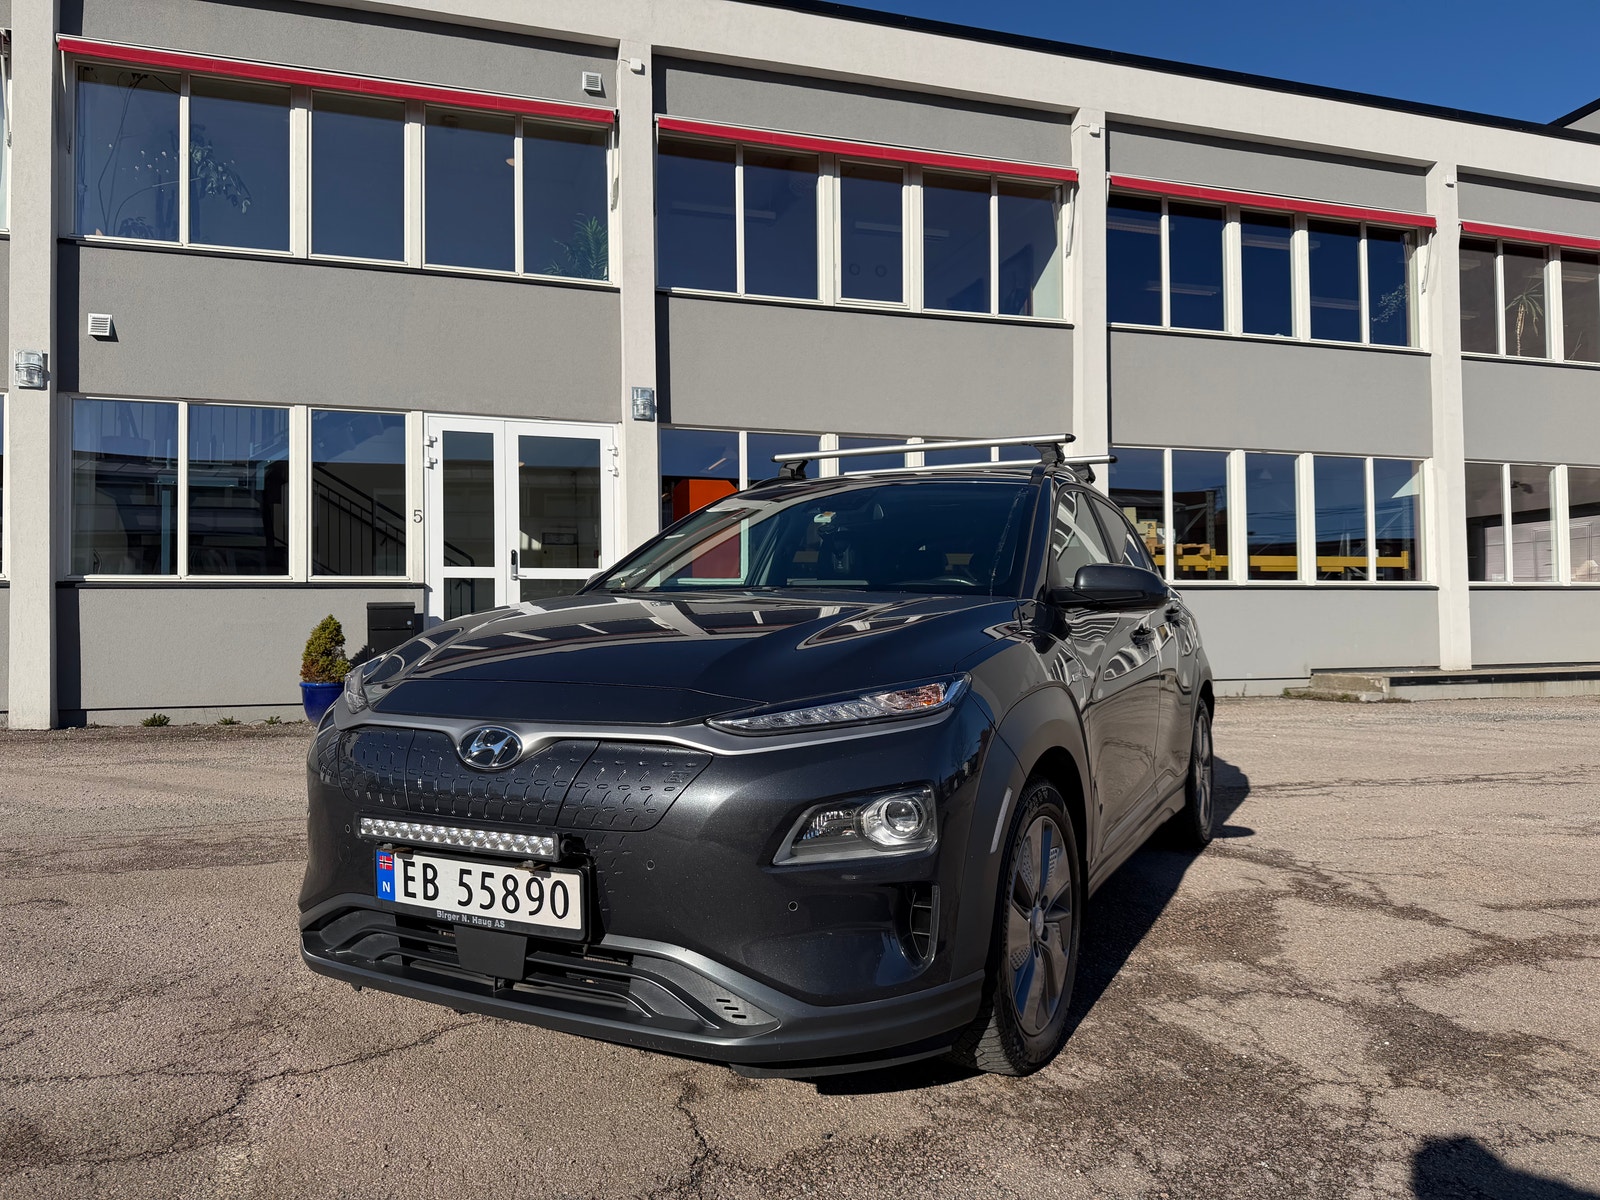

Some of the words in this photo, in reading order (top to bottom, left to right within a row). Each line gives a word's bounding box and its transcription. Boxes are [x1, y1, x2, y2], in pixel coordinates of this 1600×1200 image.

[413, 509, 423, 523] 5
[382, 880, 391, 893] N
[402, 859, 440, 902] EB
[457, 868, 570, 920] 55890
[436, 910, 460, 921] Birger
[461, 914, 470, 923] N.
[472, 916, 492, 928] Haug
[494, 919, 506, 929] AS
